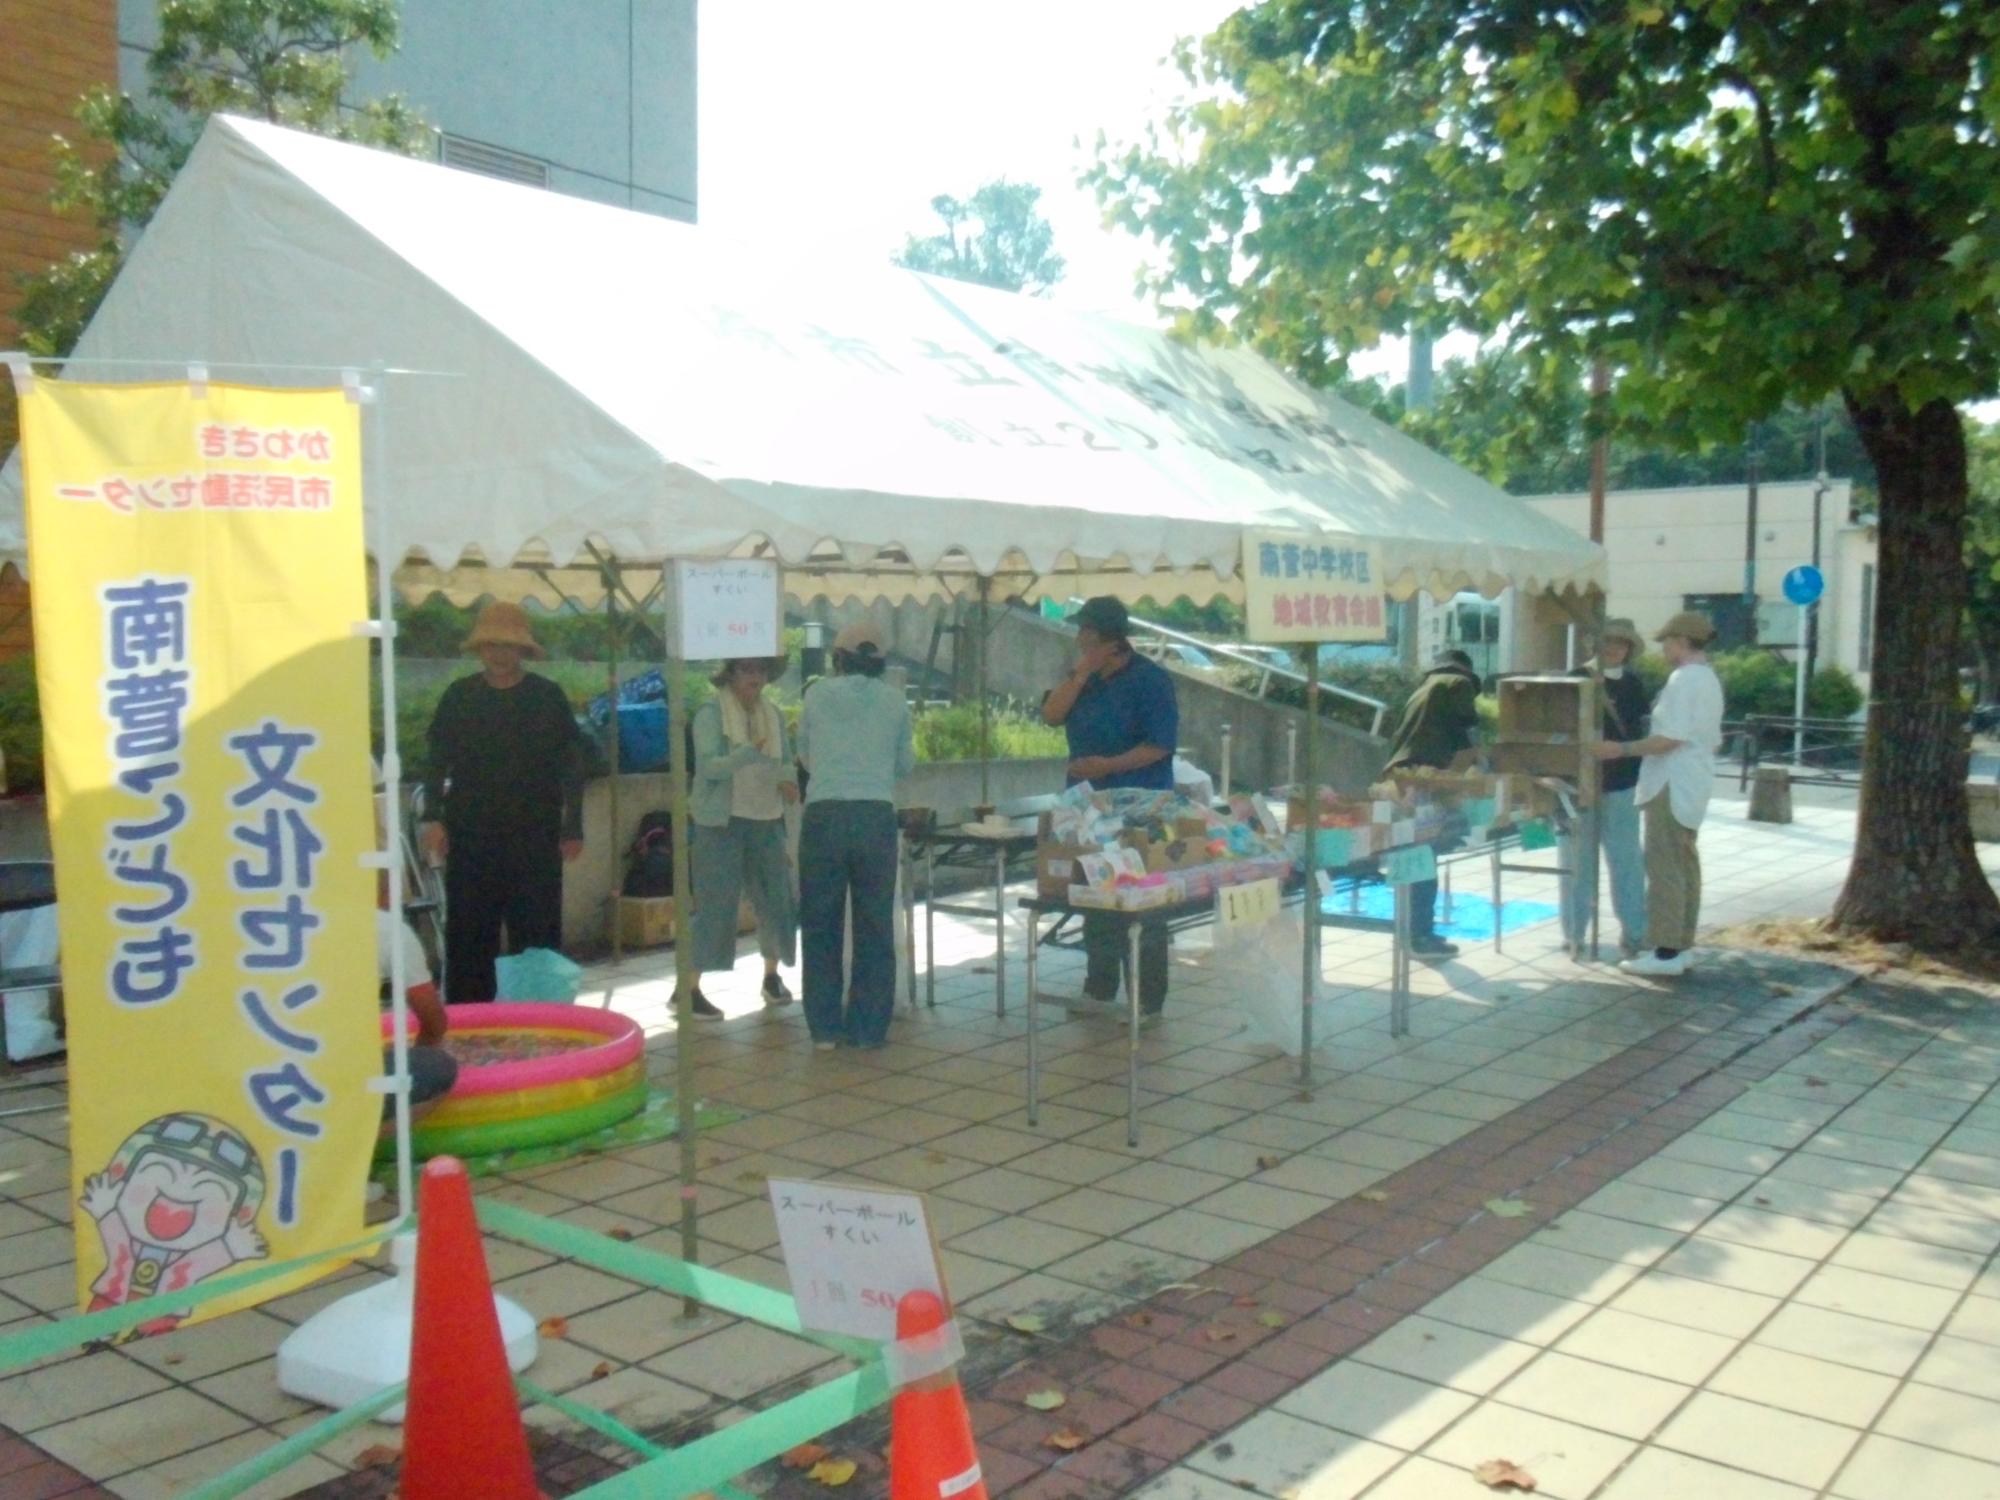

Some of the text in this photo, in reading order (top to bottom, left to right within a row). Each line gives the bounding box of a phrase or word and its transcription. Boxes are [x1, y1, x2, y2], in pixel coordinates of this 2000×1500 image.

[687, 567, 772, 579] スーパーボール
[713, 585, 747, 595] すくい
[781, 1195, 917, 1227] スーパーボール
[823, 1223, 881, 1245] すくい
